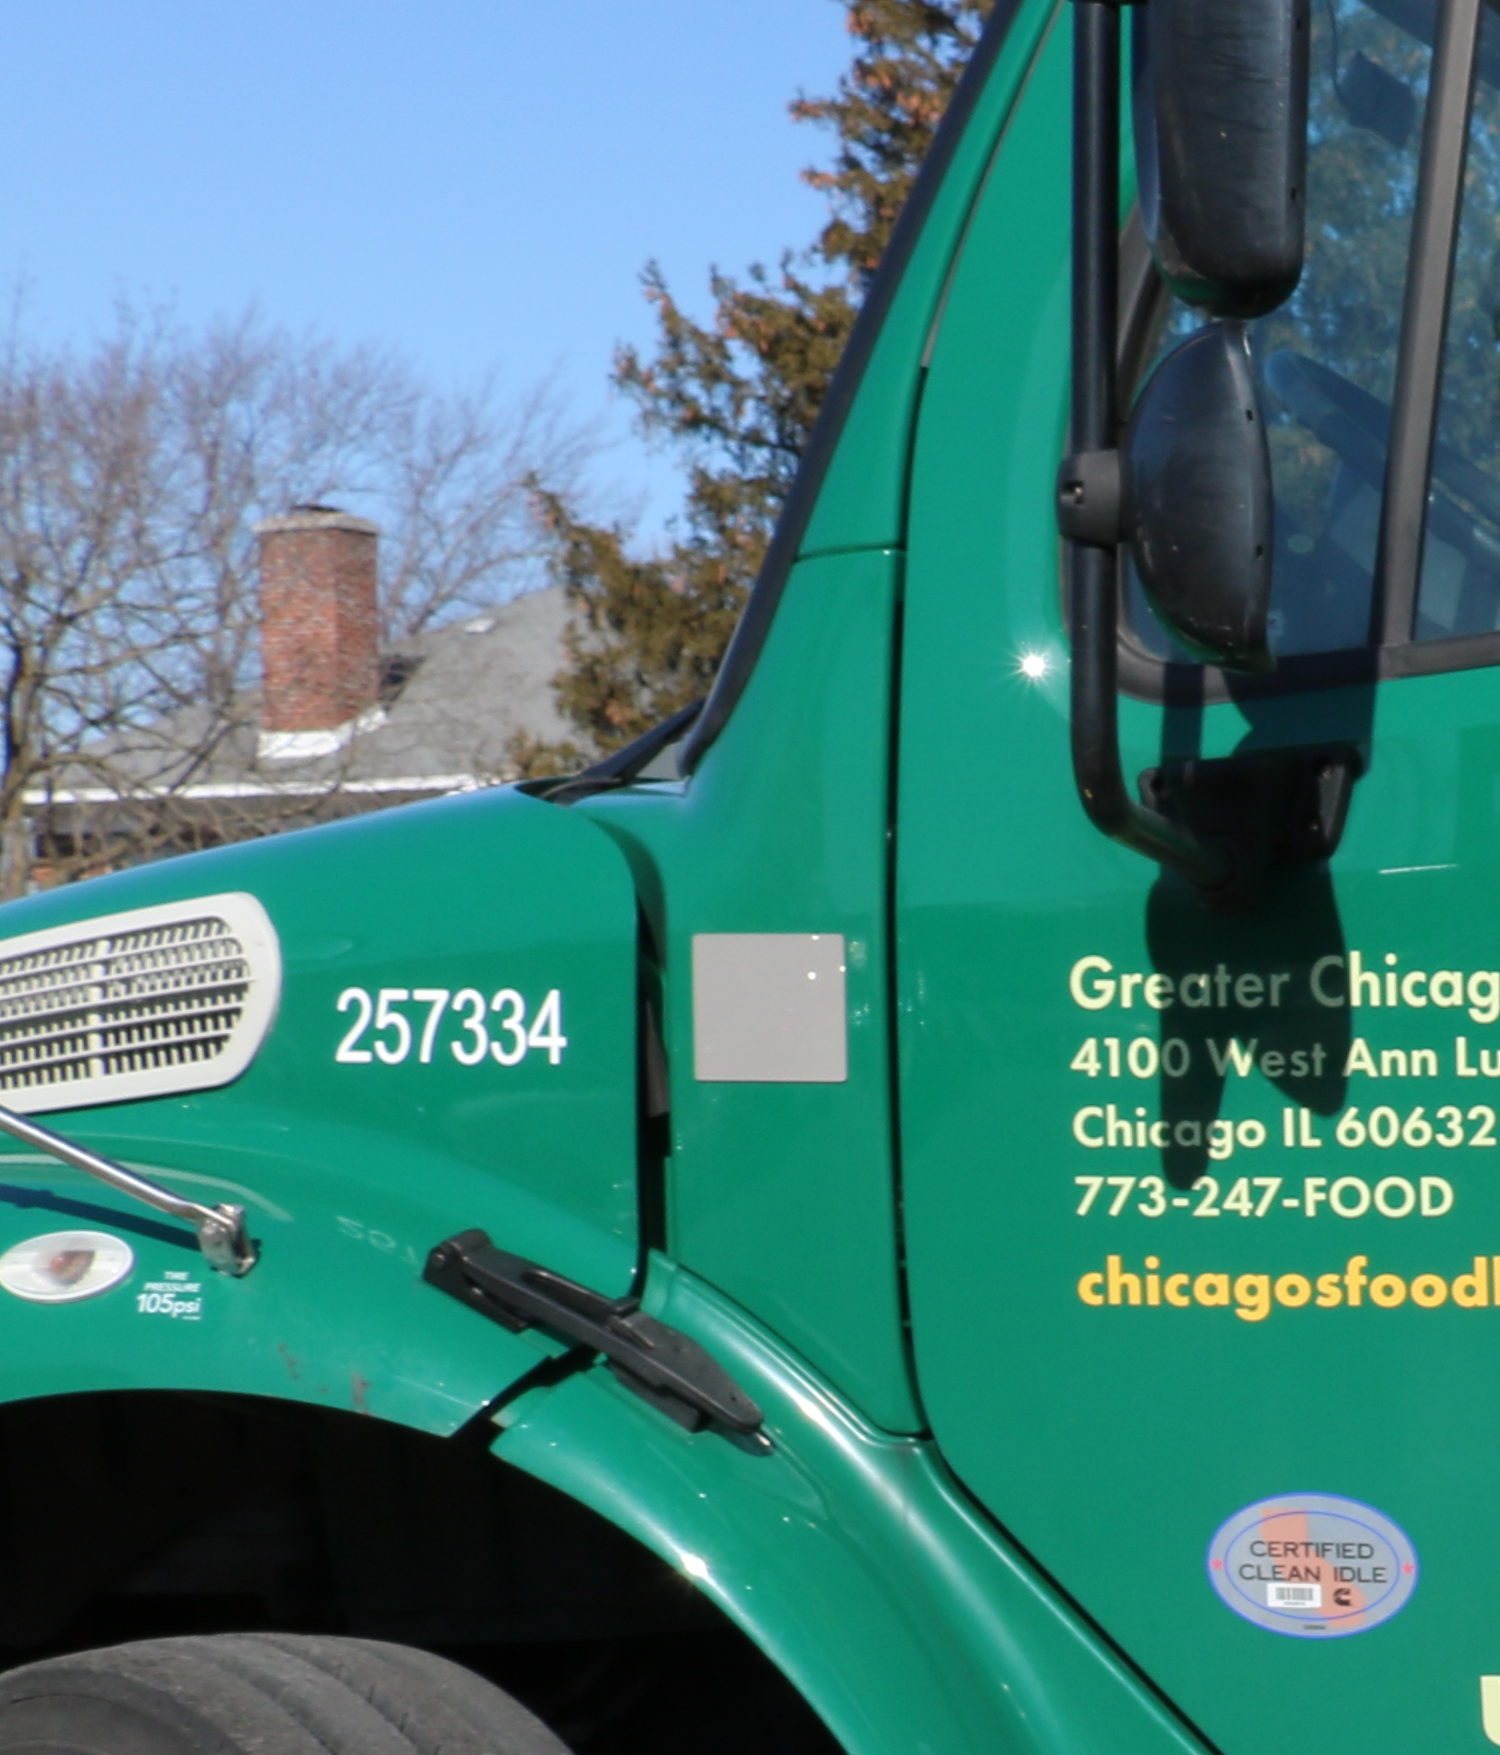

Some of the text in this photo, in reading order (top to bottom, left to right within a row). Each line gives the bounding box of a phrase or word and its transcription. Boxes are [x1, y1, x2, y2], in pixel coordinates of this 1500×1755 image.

[1069, 955, 1291, 1012] Greater
[336, 987, 568, 1066] 257334
[1069, 1036, 1191, 1082] 4100
[1208, 1038, 1327, 1080] West
[1345, 1038, 1440, 1079] Ann
[1072, 1104, 1498, 1162] Chicago IL 60632
[1075, 1176, 1456, 1220] 773-247-FOOD
[137, 1294, 202, 1318] 105psi
[1249, 1540, 1375, 1560] CERTIFIED
[1238, 1564, 1388, 1583] CLEAN IDLE
